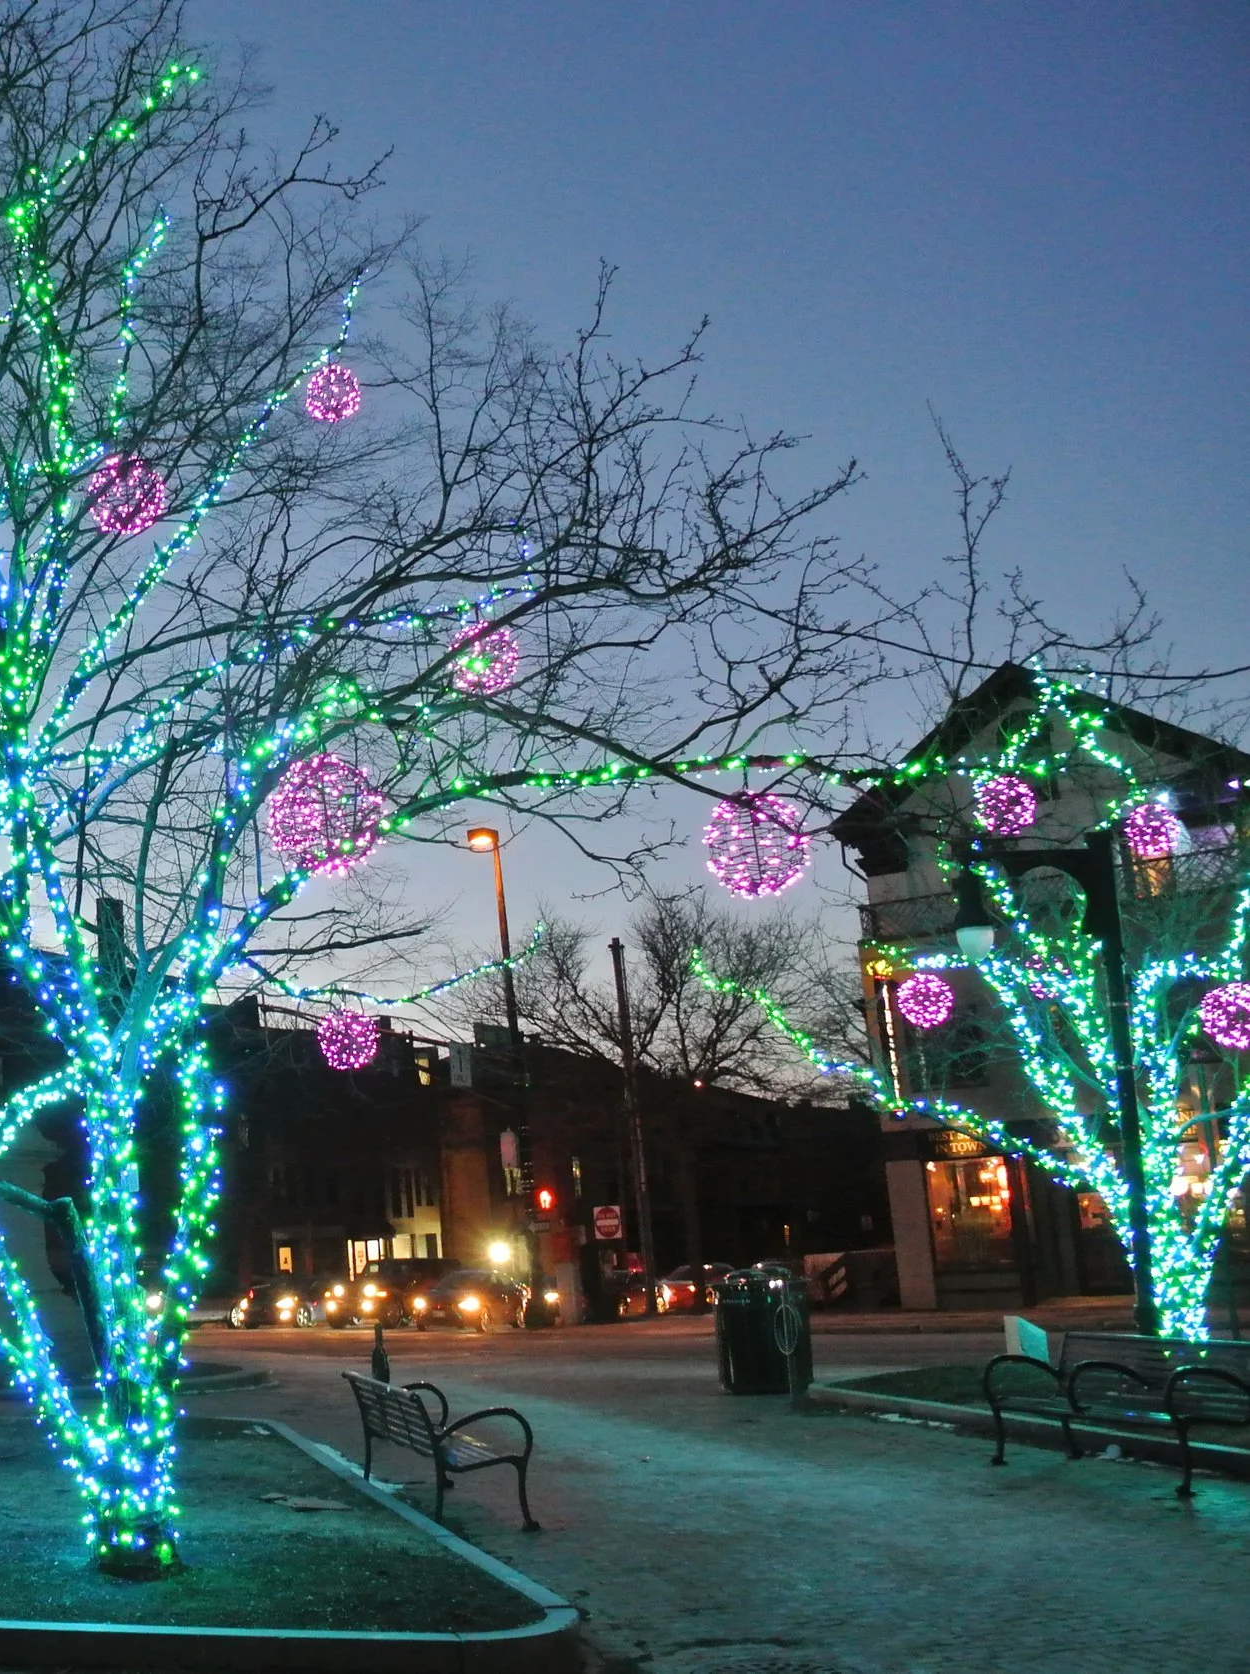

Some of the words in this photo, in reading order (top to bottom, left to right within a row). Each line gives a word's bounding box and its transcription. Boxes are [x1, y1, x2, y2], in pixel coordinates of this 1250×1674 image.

[928, 1130, 955, 1141] BEST
[935, 1143, 948, 1153] IN
[950, 1141, 987, 1153] TOWN
